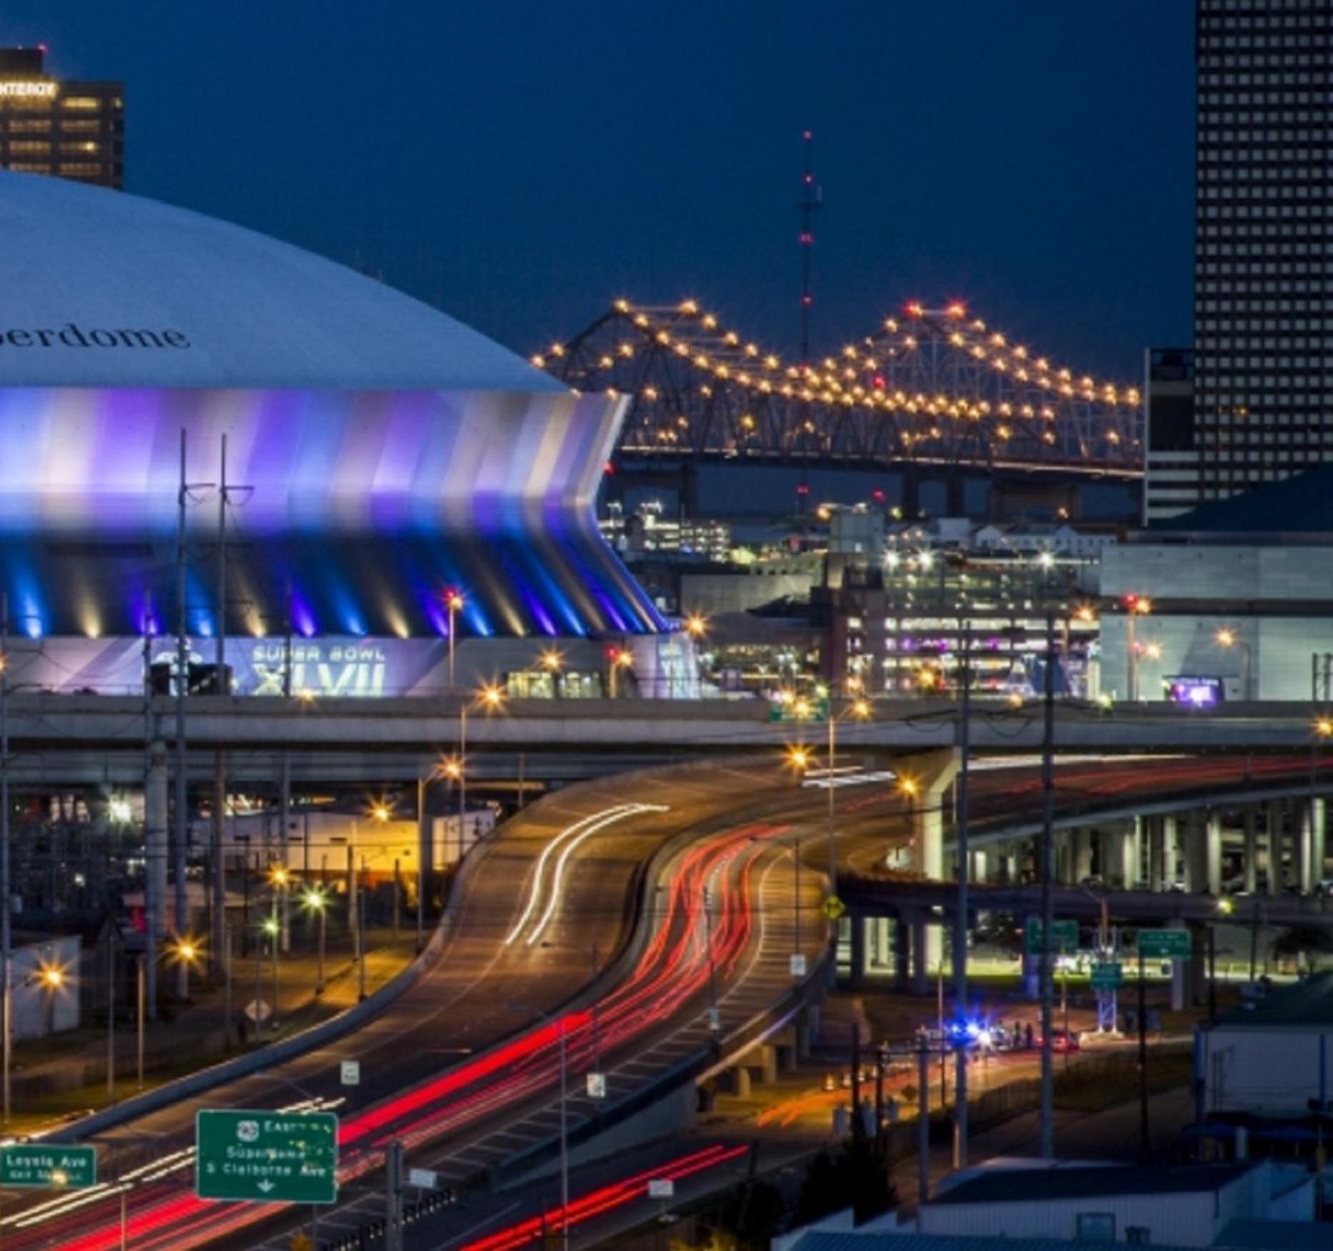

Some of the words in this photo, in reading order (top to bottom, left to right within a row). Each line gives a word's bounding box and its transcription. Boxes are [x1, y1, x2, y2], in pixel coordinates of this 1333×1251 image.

[252, 645, 321, 661] SUPER
[329, 646, 386, 662] BOWL
[252, 662, 384, 697] XLVII
[61, 1154, 87, 1168] Ave
[223, 1163, 292, 1177] Claiborne
